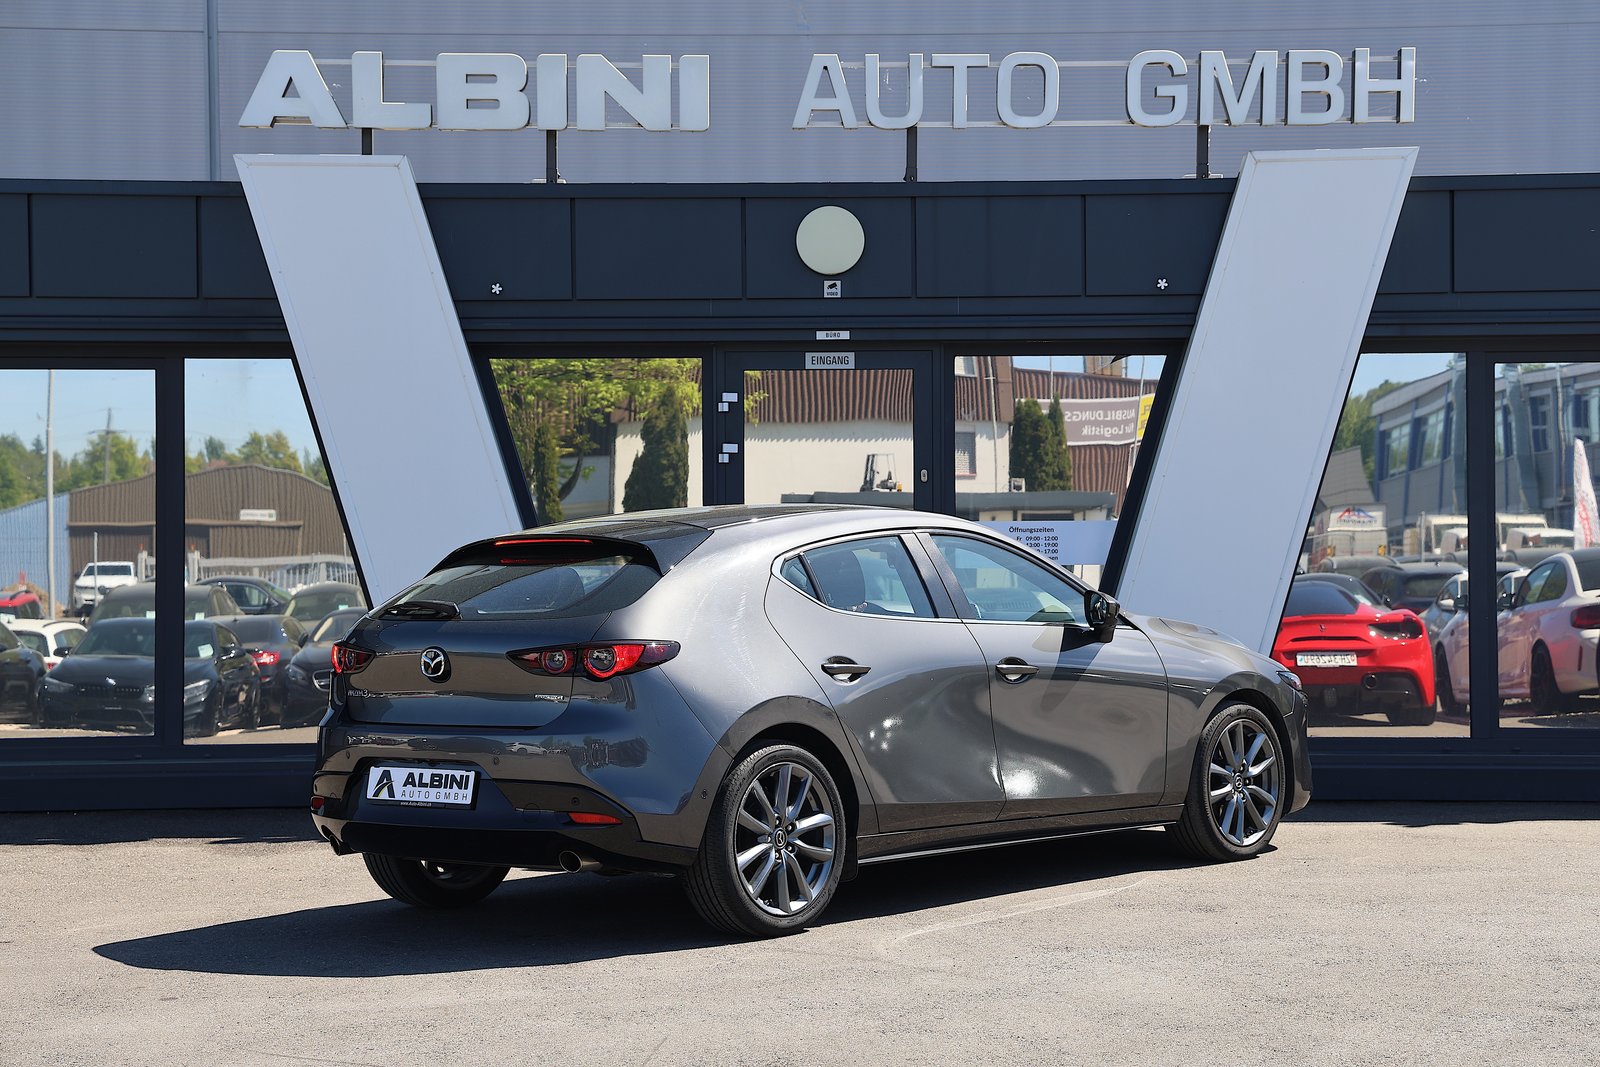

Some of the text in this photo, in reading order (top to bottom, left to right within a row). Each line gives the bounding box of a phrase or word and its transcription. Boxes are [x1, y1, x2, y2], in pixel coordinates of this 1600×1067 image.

[238, 46, 1416, 132] ALBINI AUTO GMBH
[811, 355, 850, 365] EINGANG
[402, 772, 470, 790] ALBINI
[401, 790, 468, 801] AUTO GMBH
